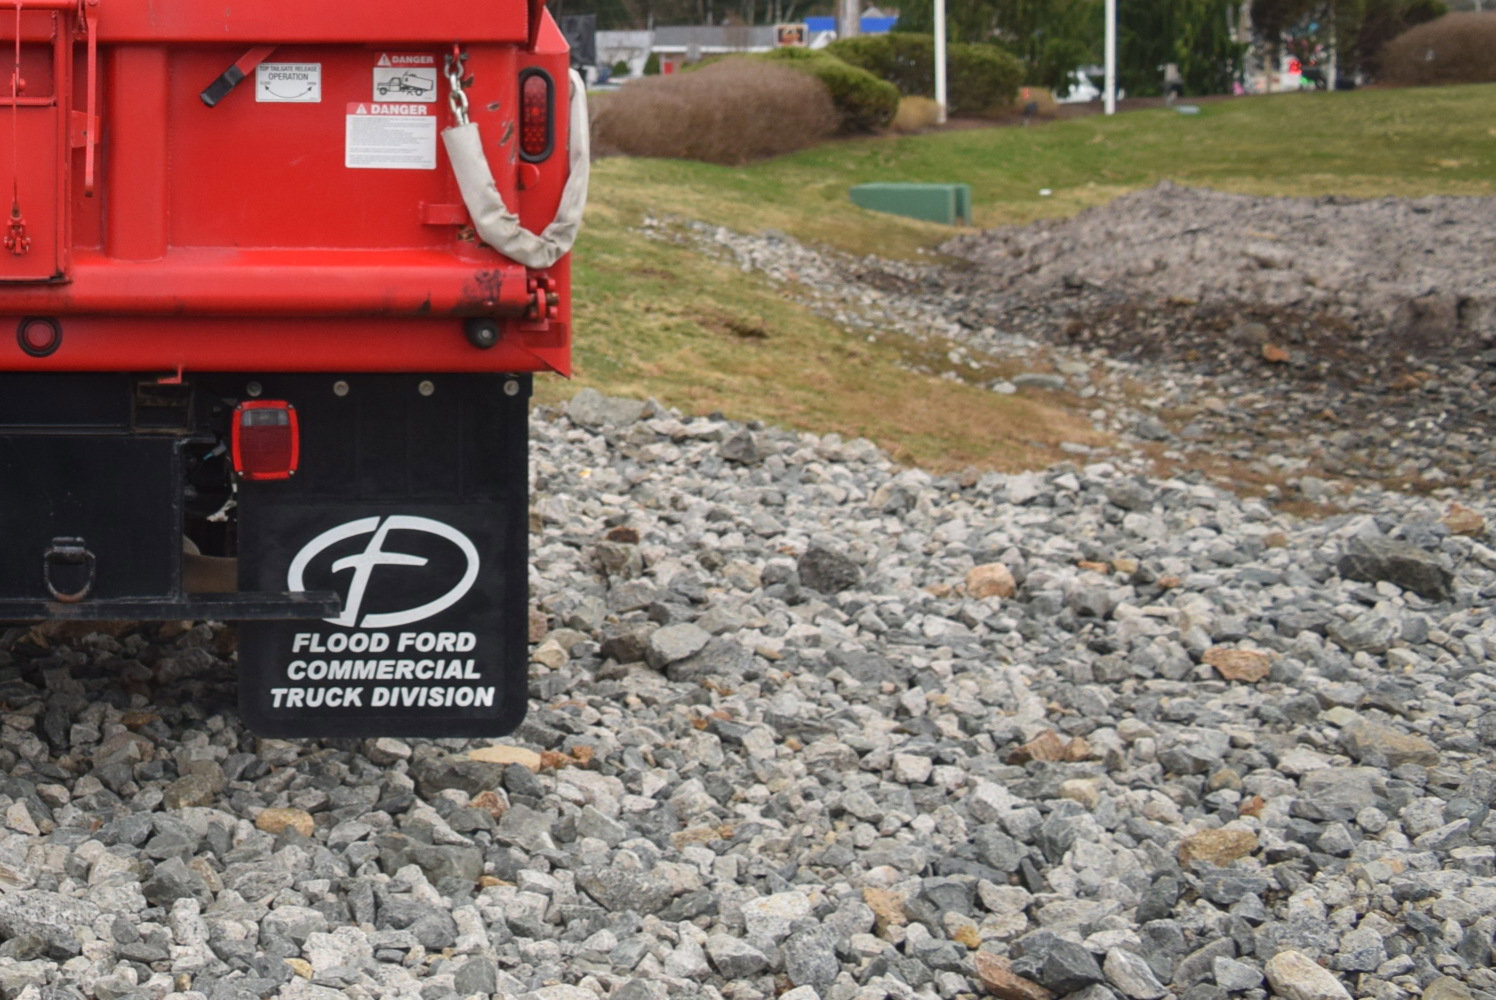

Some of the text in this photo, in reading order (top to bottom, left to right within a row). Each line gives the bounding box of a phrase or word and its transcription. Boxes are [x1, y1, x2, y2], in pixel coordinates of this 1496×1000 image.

[391, 55, 434, 64] DANGER
[268, 72, 309, 81] OPERATION
[370, 104, 428, 116] DANGER
[291, 631, 477, 653] FLOOD FORD
[286, 658, 482, 681] COMMERCIAL
[270, 686, 496, 708] TRUCK DIVISION
